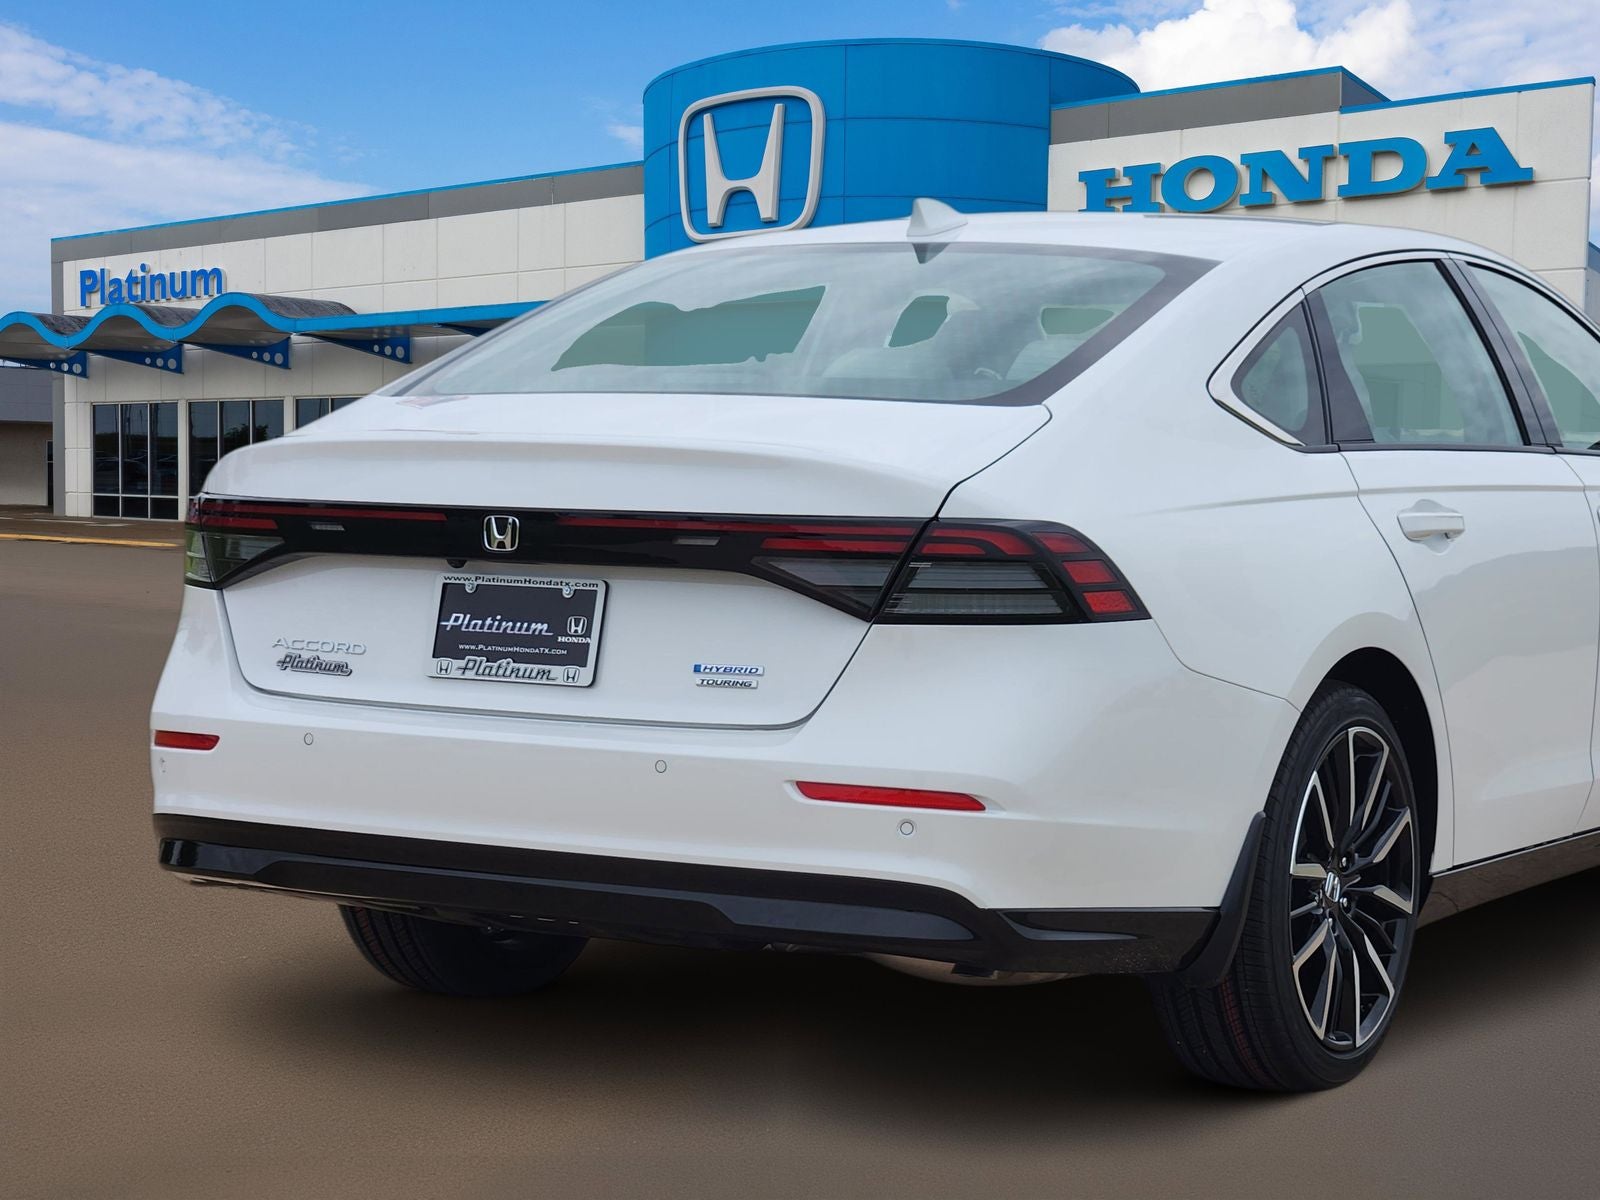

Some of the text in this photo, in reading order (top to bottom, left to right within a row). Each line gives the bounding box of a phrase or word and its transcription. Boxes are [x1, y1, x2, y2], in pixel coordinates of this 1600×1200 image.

[1079, 126, 1535, 213] HONDA
[79, 263, 227, 307] Platinum
[440, 613, 553, 636] Platinum
[272, 637, 367, 655] ACCORD
[557, 635, 591, 643] HONDA
[276, 652, 353, 677] Platinum
[457, 658, 558, 681] Platinum
[703, 665, 759, 674] HYBRID
[700, 678, 753, 688] TOURING
